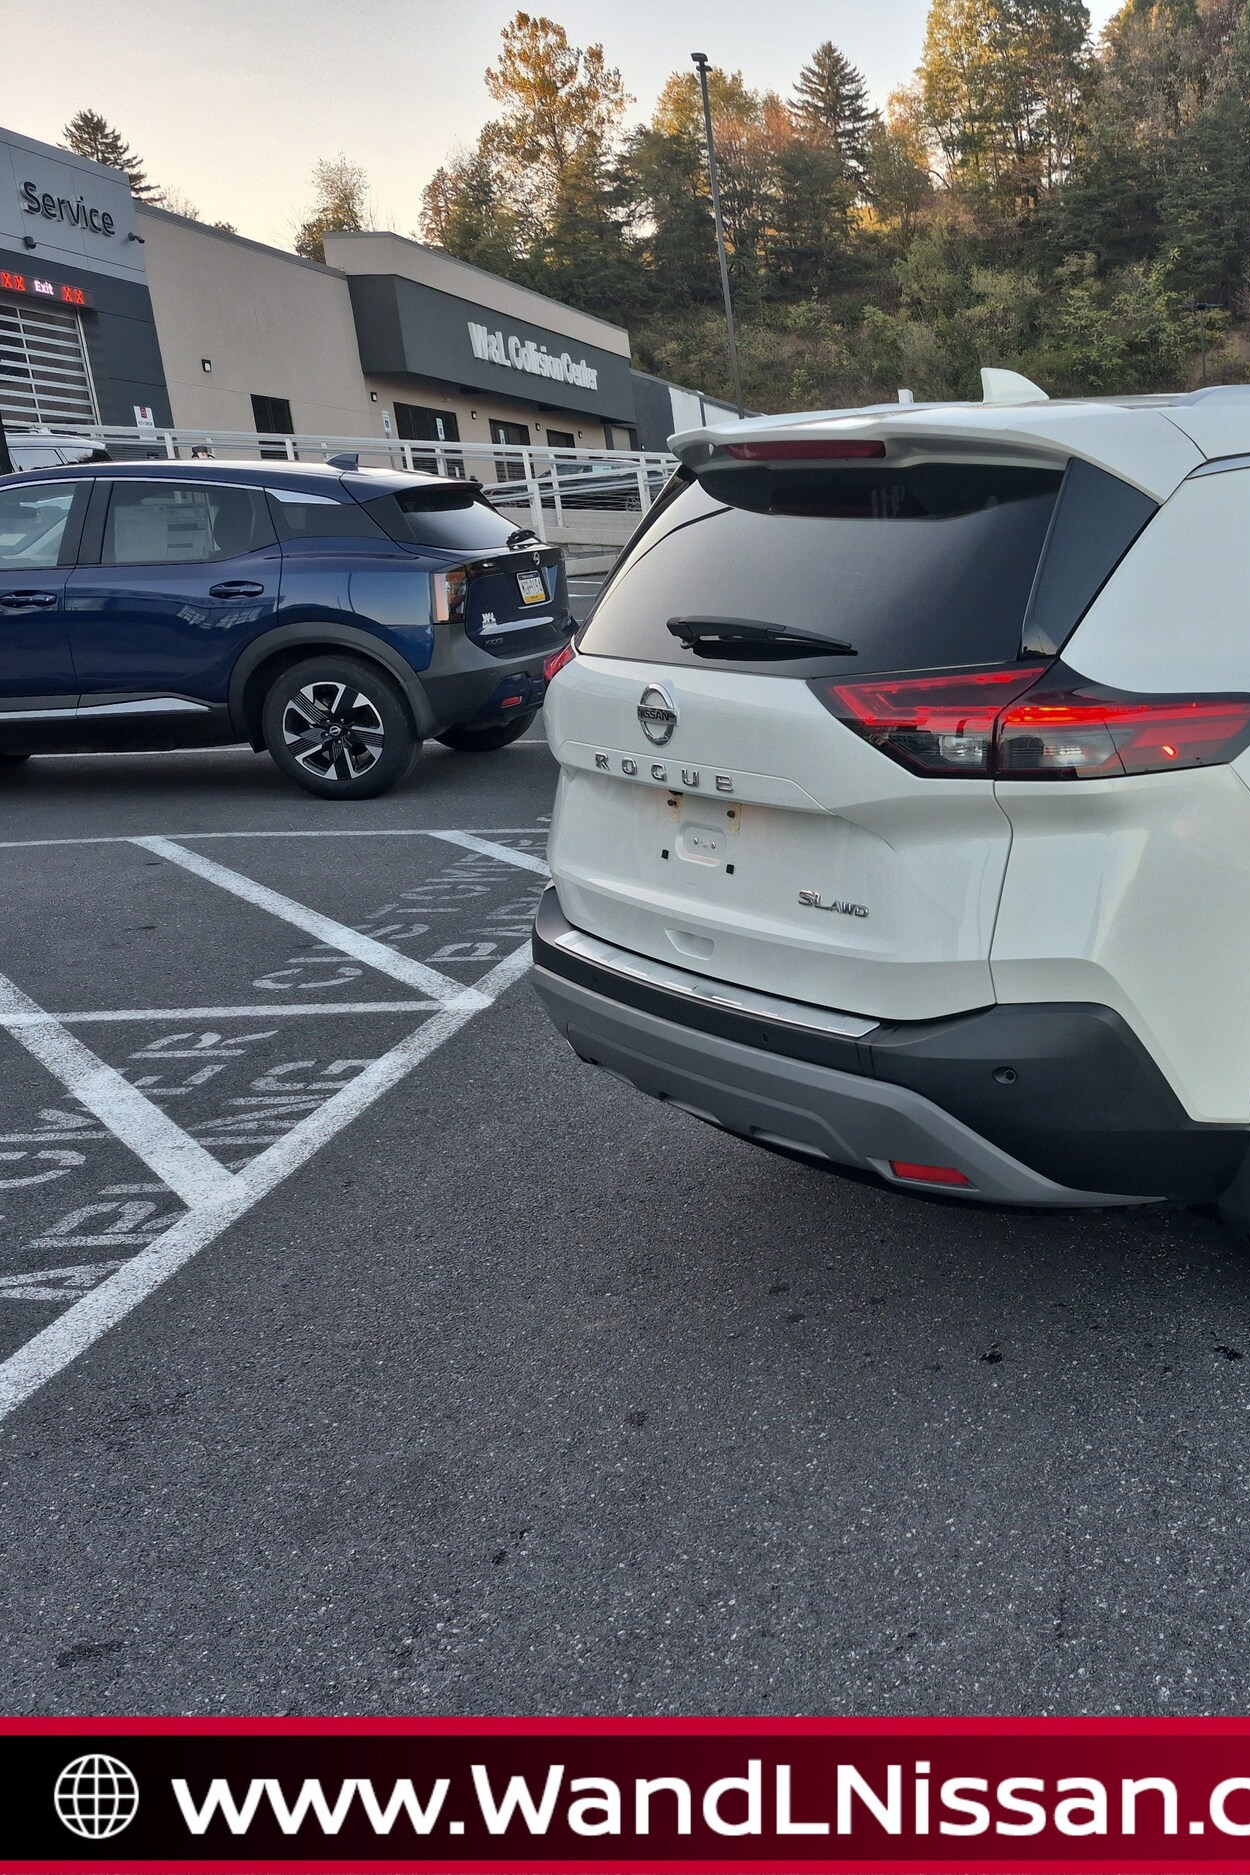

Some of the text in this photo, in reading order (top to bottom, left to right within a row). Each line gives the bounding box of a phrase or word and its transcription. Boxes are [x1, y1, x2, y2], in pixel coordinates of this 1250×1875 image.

[21, 180, 116, 236] Service
[33, 279, 55, 296] Exit
[467, 321, 598, 391] W&L Collision Center
[595, 751, 734, 793] ROGUE
[798, 889, 870, 918] SL AWD
